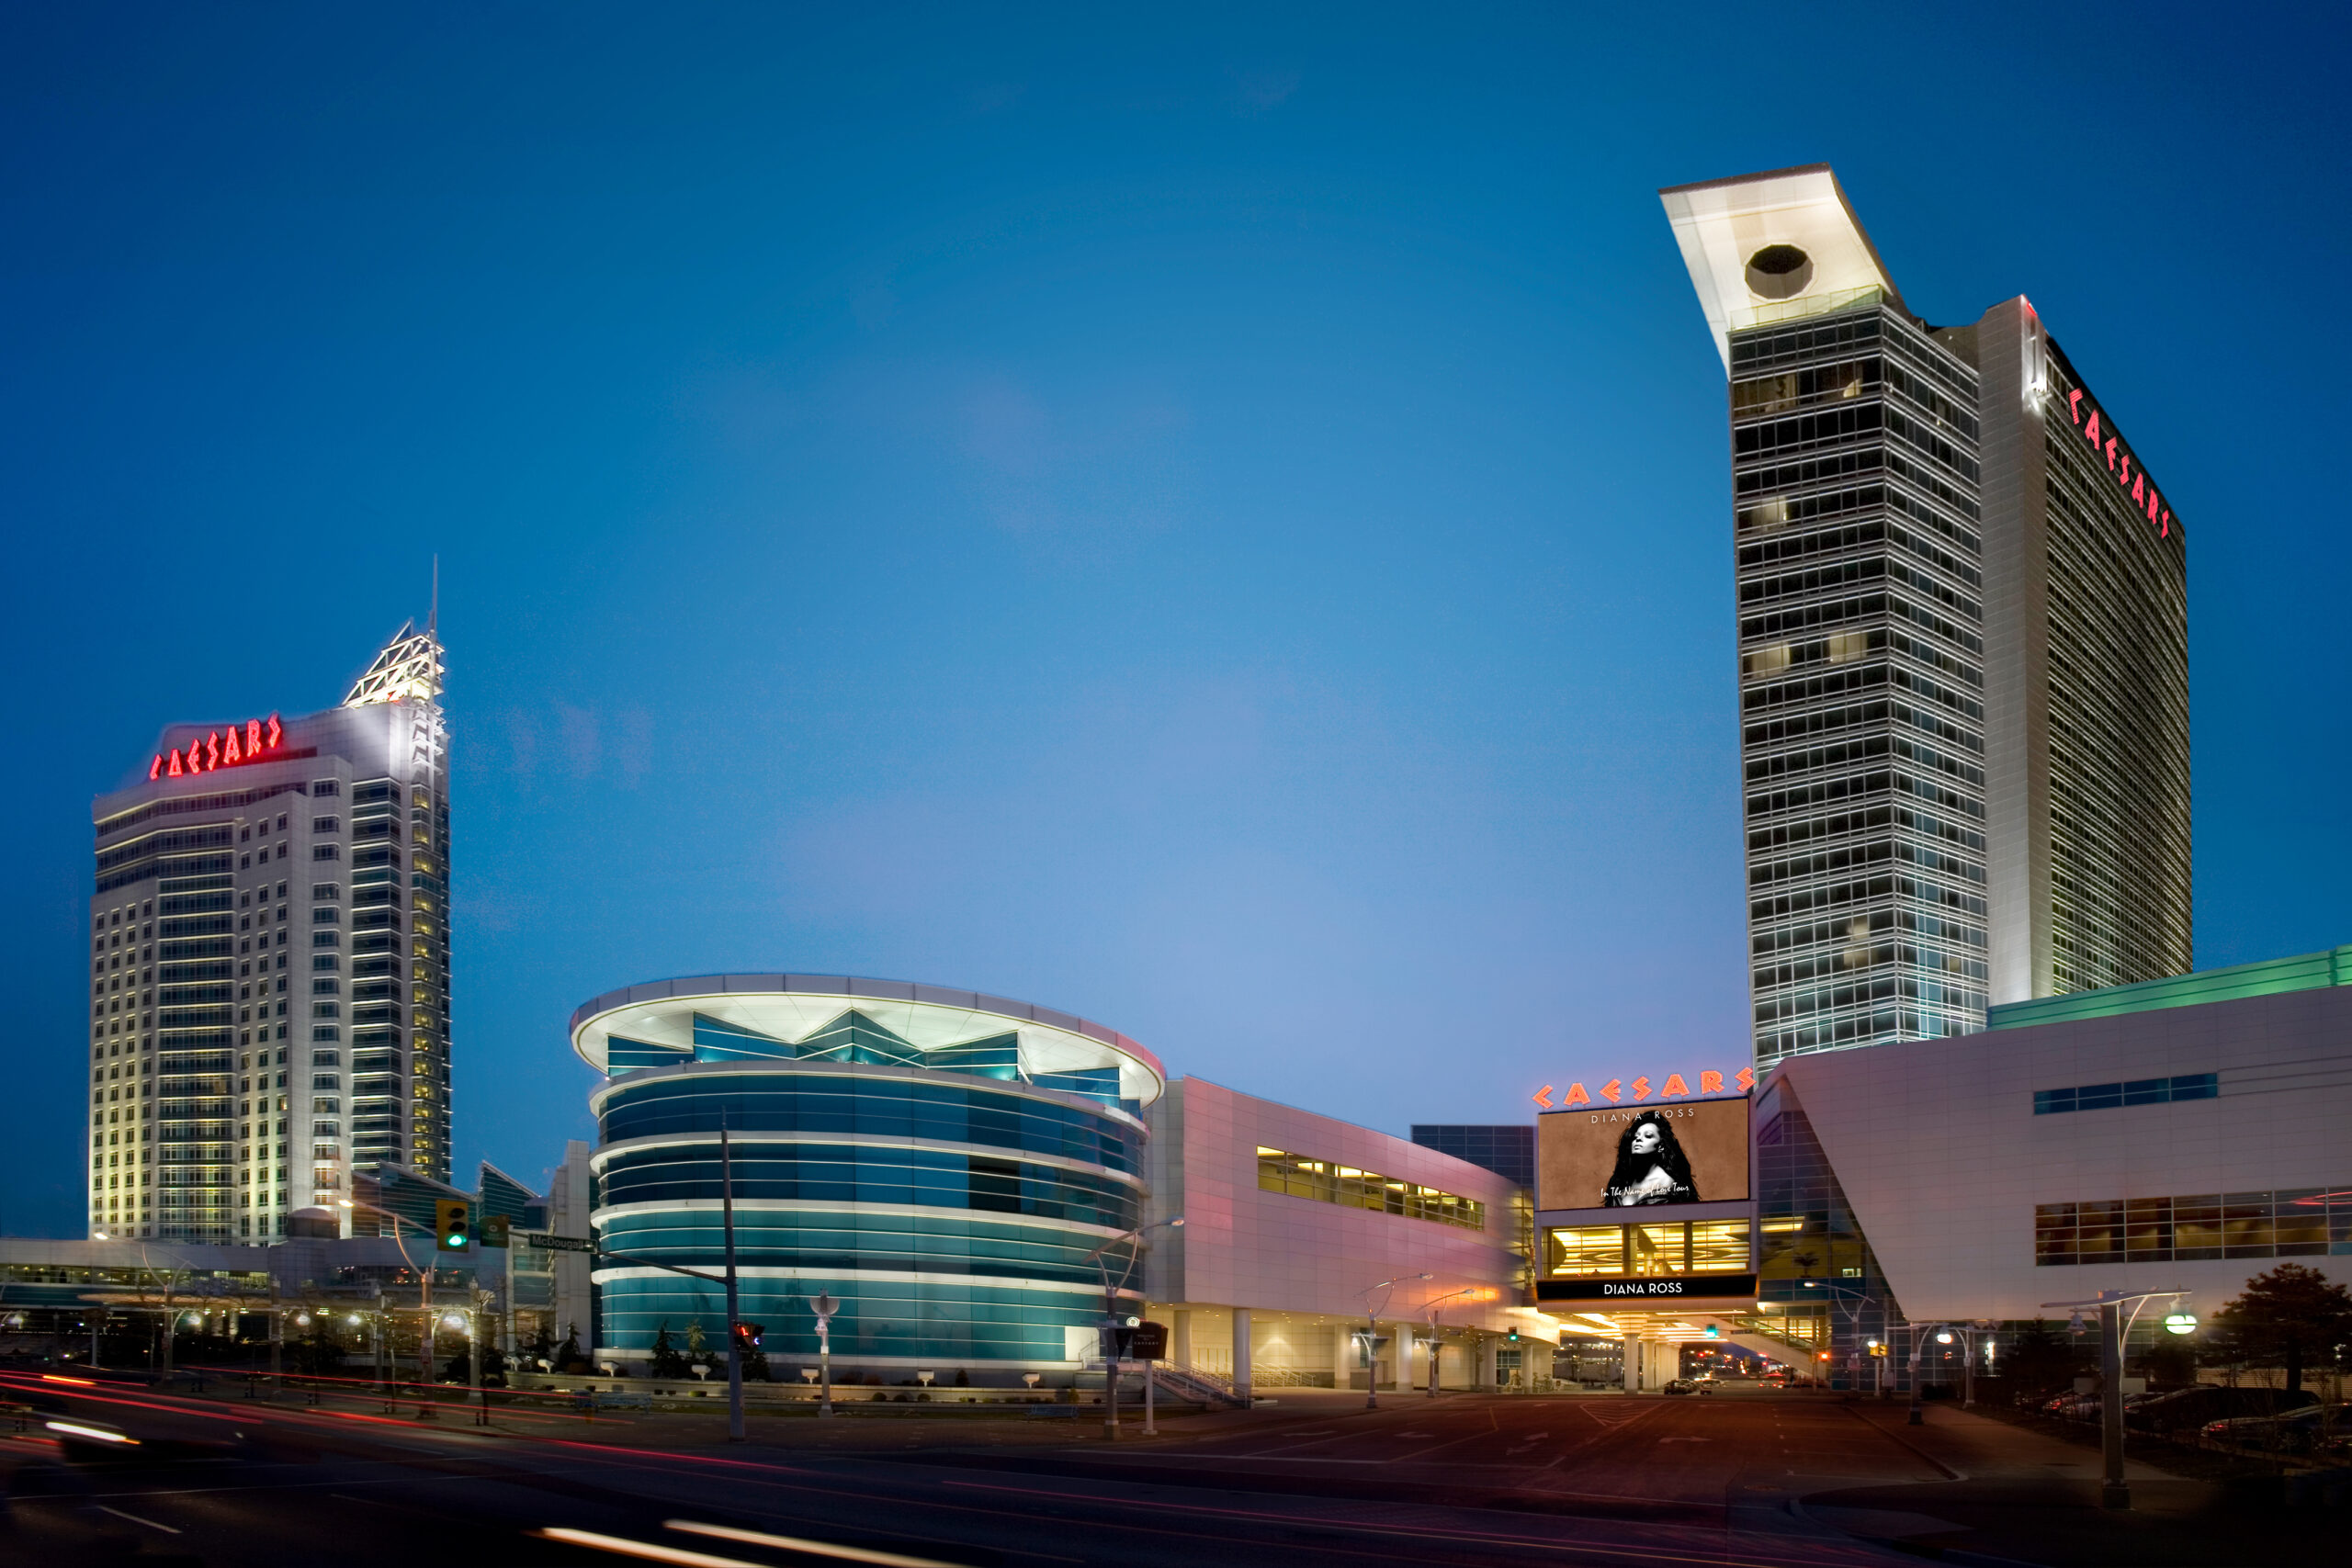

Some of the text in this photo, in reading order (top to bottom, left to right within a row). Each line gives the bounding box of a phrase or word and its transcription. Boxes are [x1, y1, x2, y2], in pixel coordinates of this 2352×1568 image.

[2069, 388, 2169, 539] CAESARS
[150, 711, 282, 780] CAESARS
[1532, 1066, 1757, 1108] CAESARS
[1591, 1108, 1694, 1123] DIANA ROSS
[1611, 1187, 1622, 1196] The
[1623, 1186, 1644, 1197] Name
[1645, 1186, 1654, 1197] of
[1656, 1183, 1671, 1194] Love
[1672, 1182, 1690, 1192] Tour
[532, 1235, 583, 1249] McDougall
[1604, 1282, 1682, 1295] DIANA ROSS
